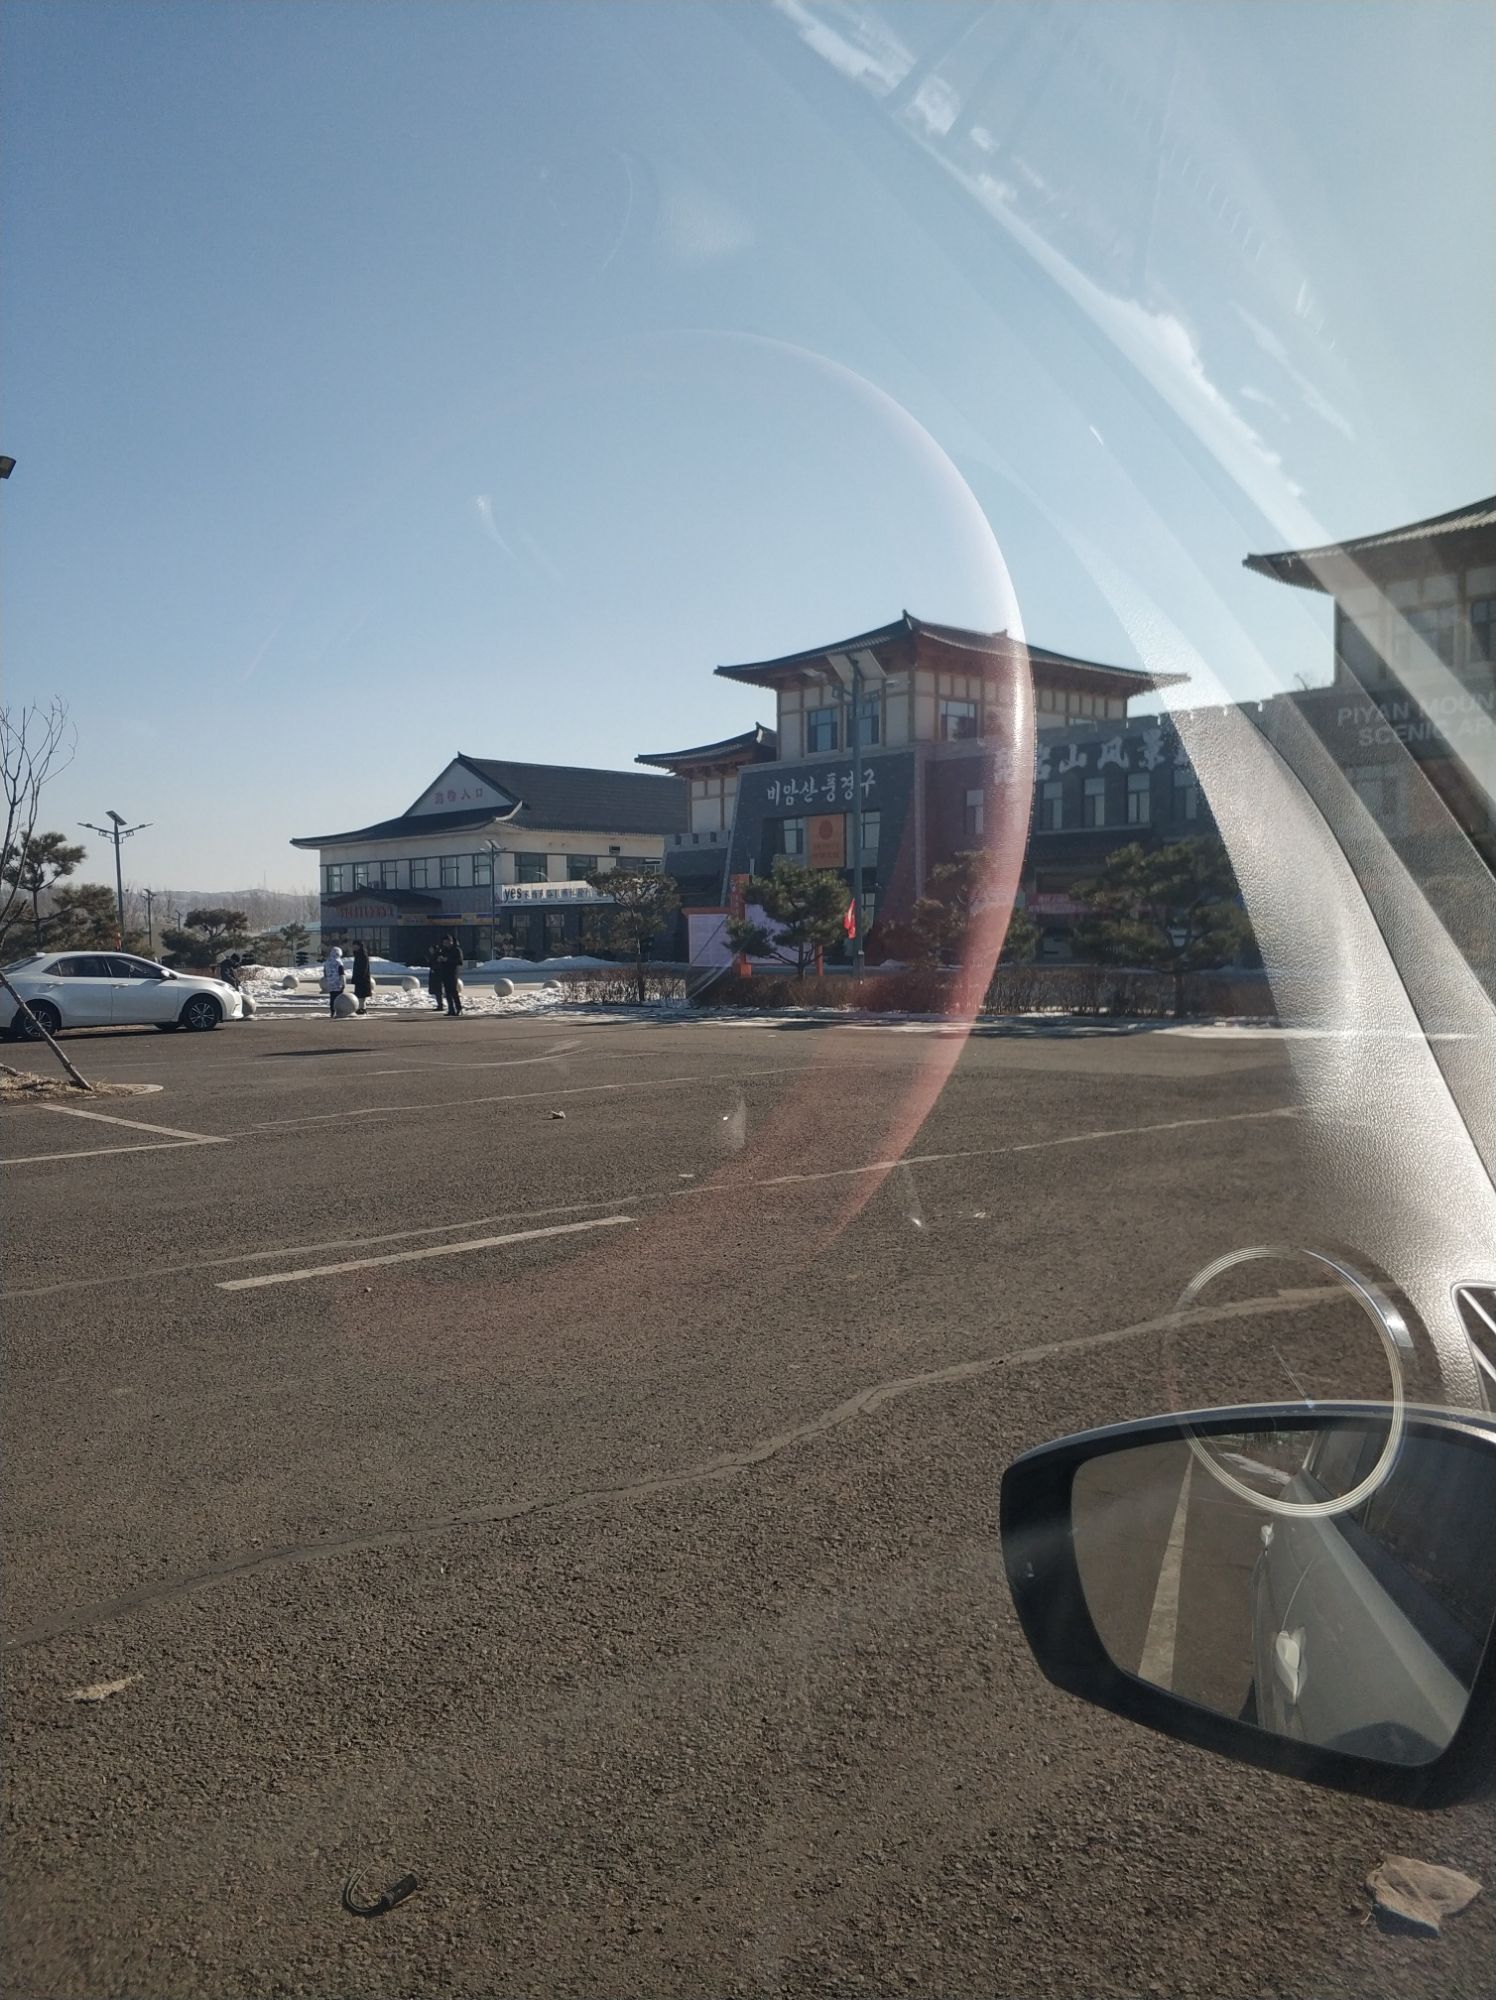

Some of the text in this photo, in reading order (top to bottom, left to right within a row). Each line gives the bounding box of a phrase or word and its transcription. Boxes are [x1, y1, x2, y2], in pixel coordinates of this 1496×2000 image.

[1336, 701, 1410, 728] PIYAN
[1357, 719, 1447, 747] SCENIC
[993, 728, 1190, 785] 岩山风景
[766, 767, 877, 807] 비암산풍경구
[504, 886, 522, 904] yes
